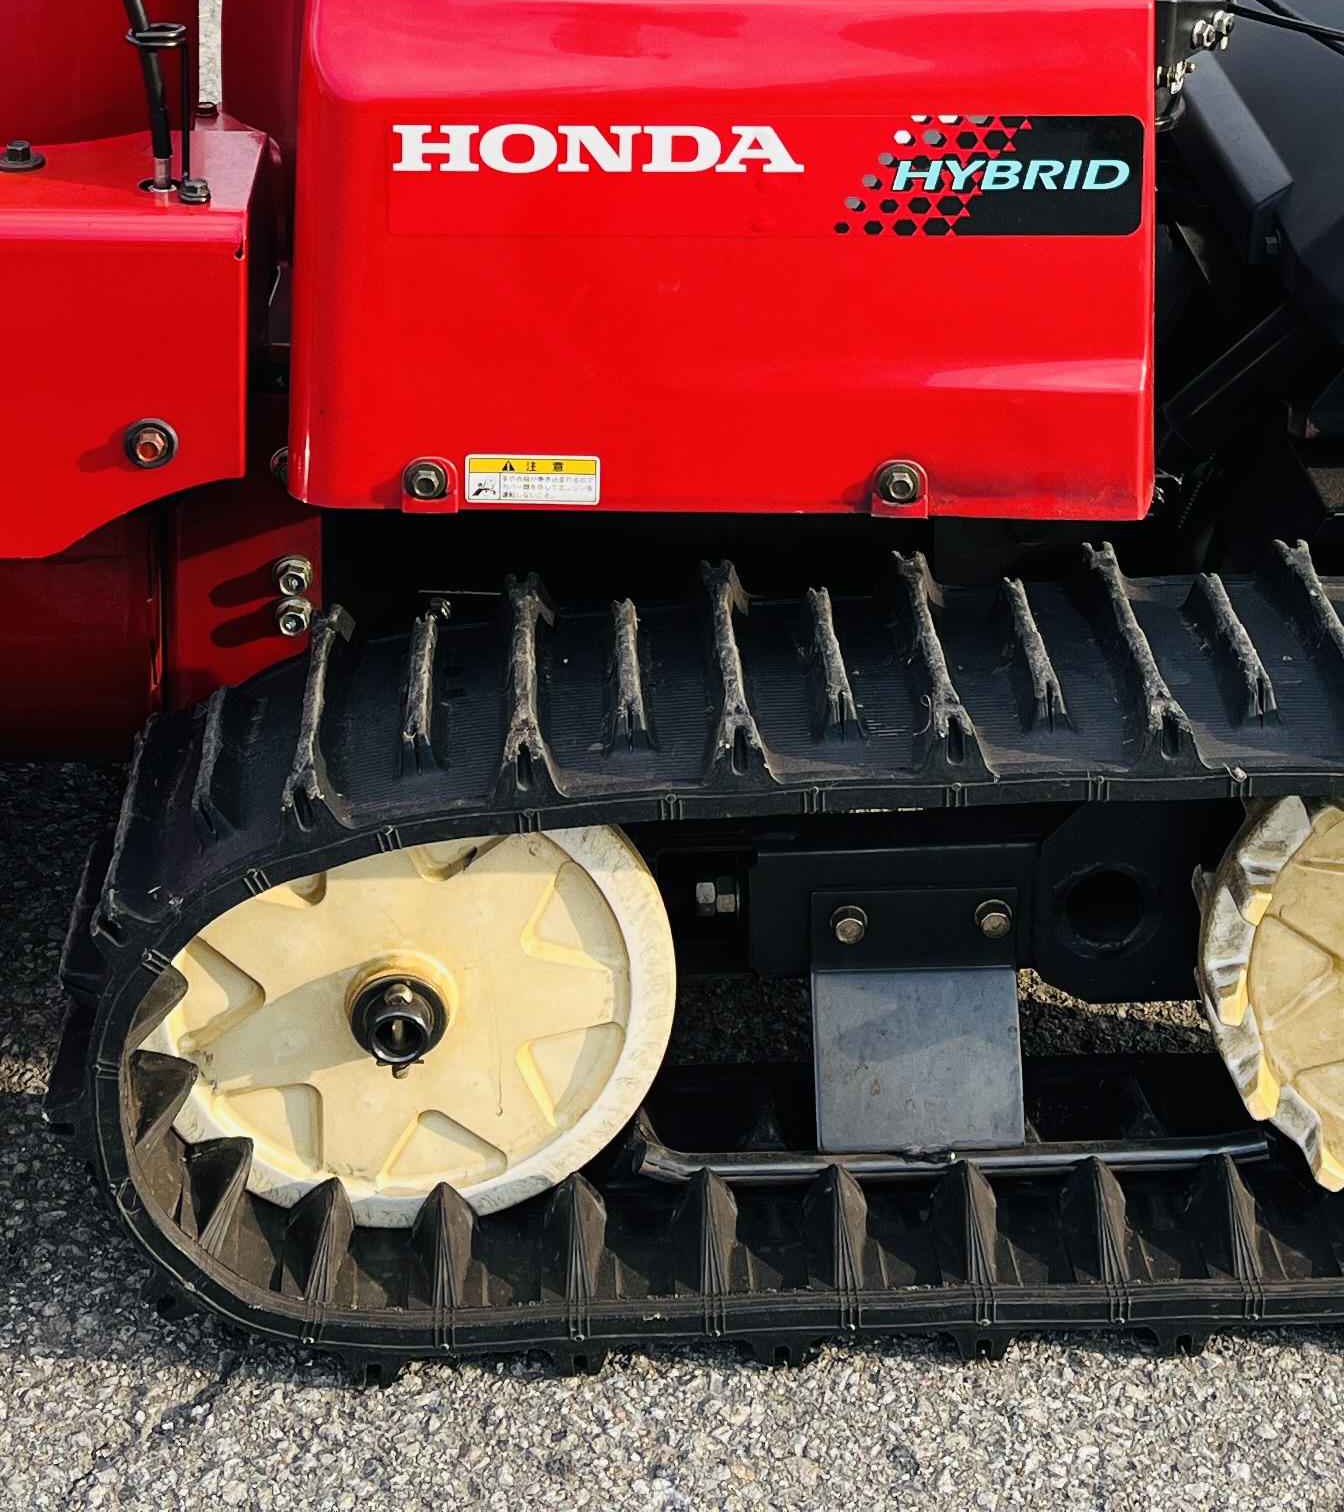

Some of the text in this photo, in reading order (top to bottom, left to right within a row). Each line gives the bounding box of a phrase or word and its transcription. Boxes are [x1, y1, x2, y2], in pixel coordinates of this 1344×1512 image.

[392, 122, 805, 174] HONDA
[891, 158, 1133, 192] HYBRID
[526, 461, 564, 473] 注意
